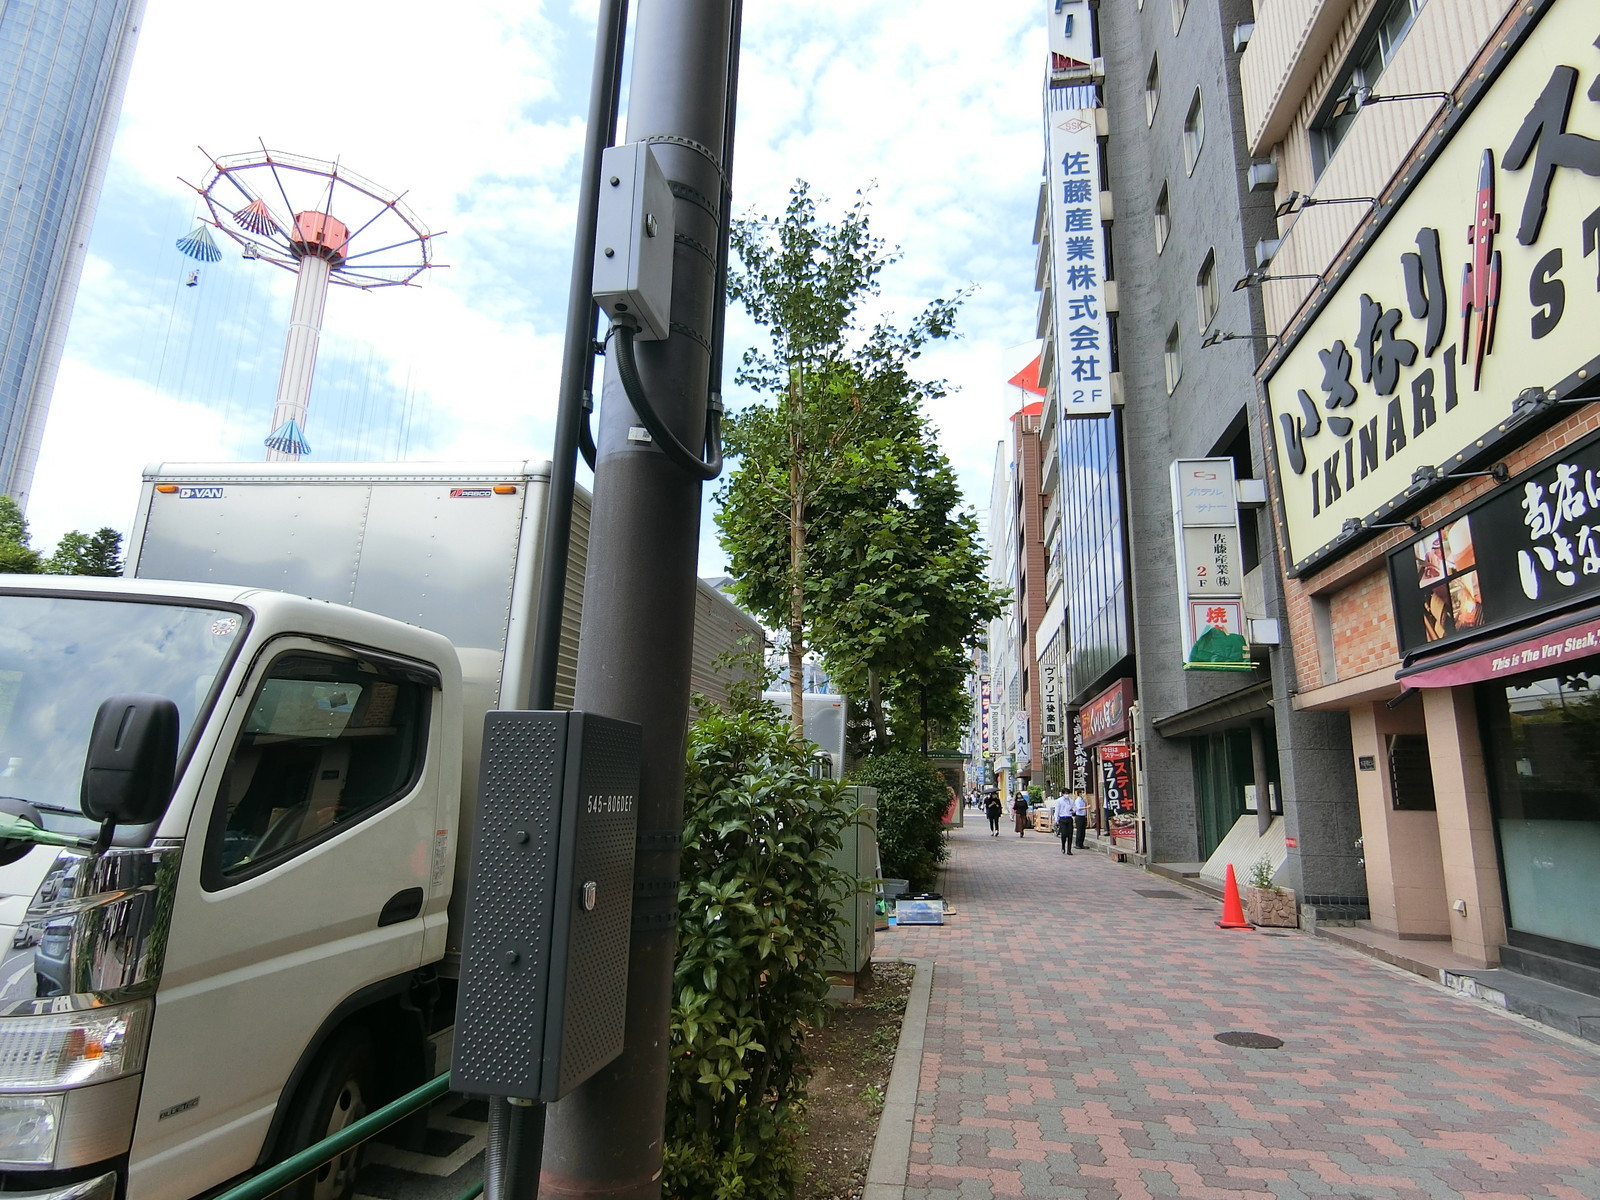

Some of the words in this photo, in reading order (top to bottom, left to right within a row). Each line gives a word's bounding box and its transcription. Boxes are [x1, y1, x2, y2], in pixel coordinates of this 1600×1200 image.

[1065, 121, 1084, 131] SSK
[1062, 152, 1101, 382] 佐藤産業株式会社
[1279, 227, 1447, 475] いきなり
[1072, 389, 1103, 403] 2F
[1312, 343, 1458, 518] IKINARI
[1492, 656, 1510, 671] This
[1511, 653, 1520, 666] is
[1521, 649, 1540, 664] The
[1542, 643, 1563, 658] Very
[1044, 667, 1056, 733] ヴァリエ後楽園
[1017, 735, 1027, 755] 丸八
[1115, 762, 1133, 810] ステーキ
